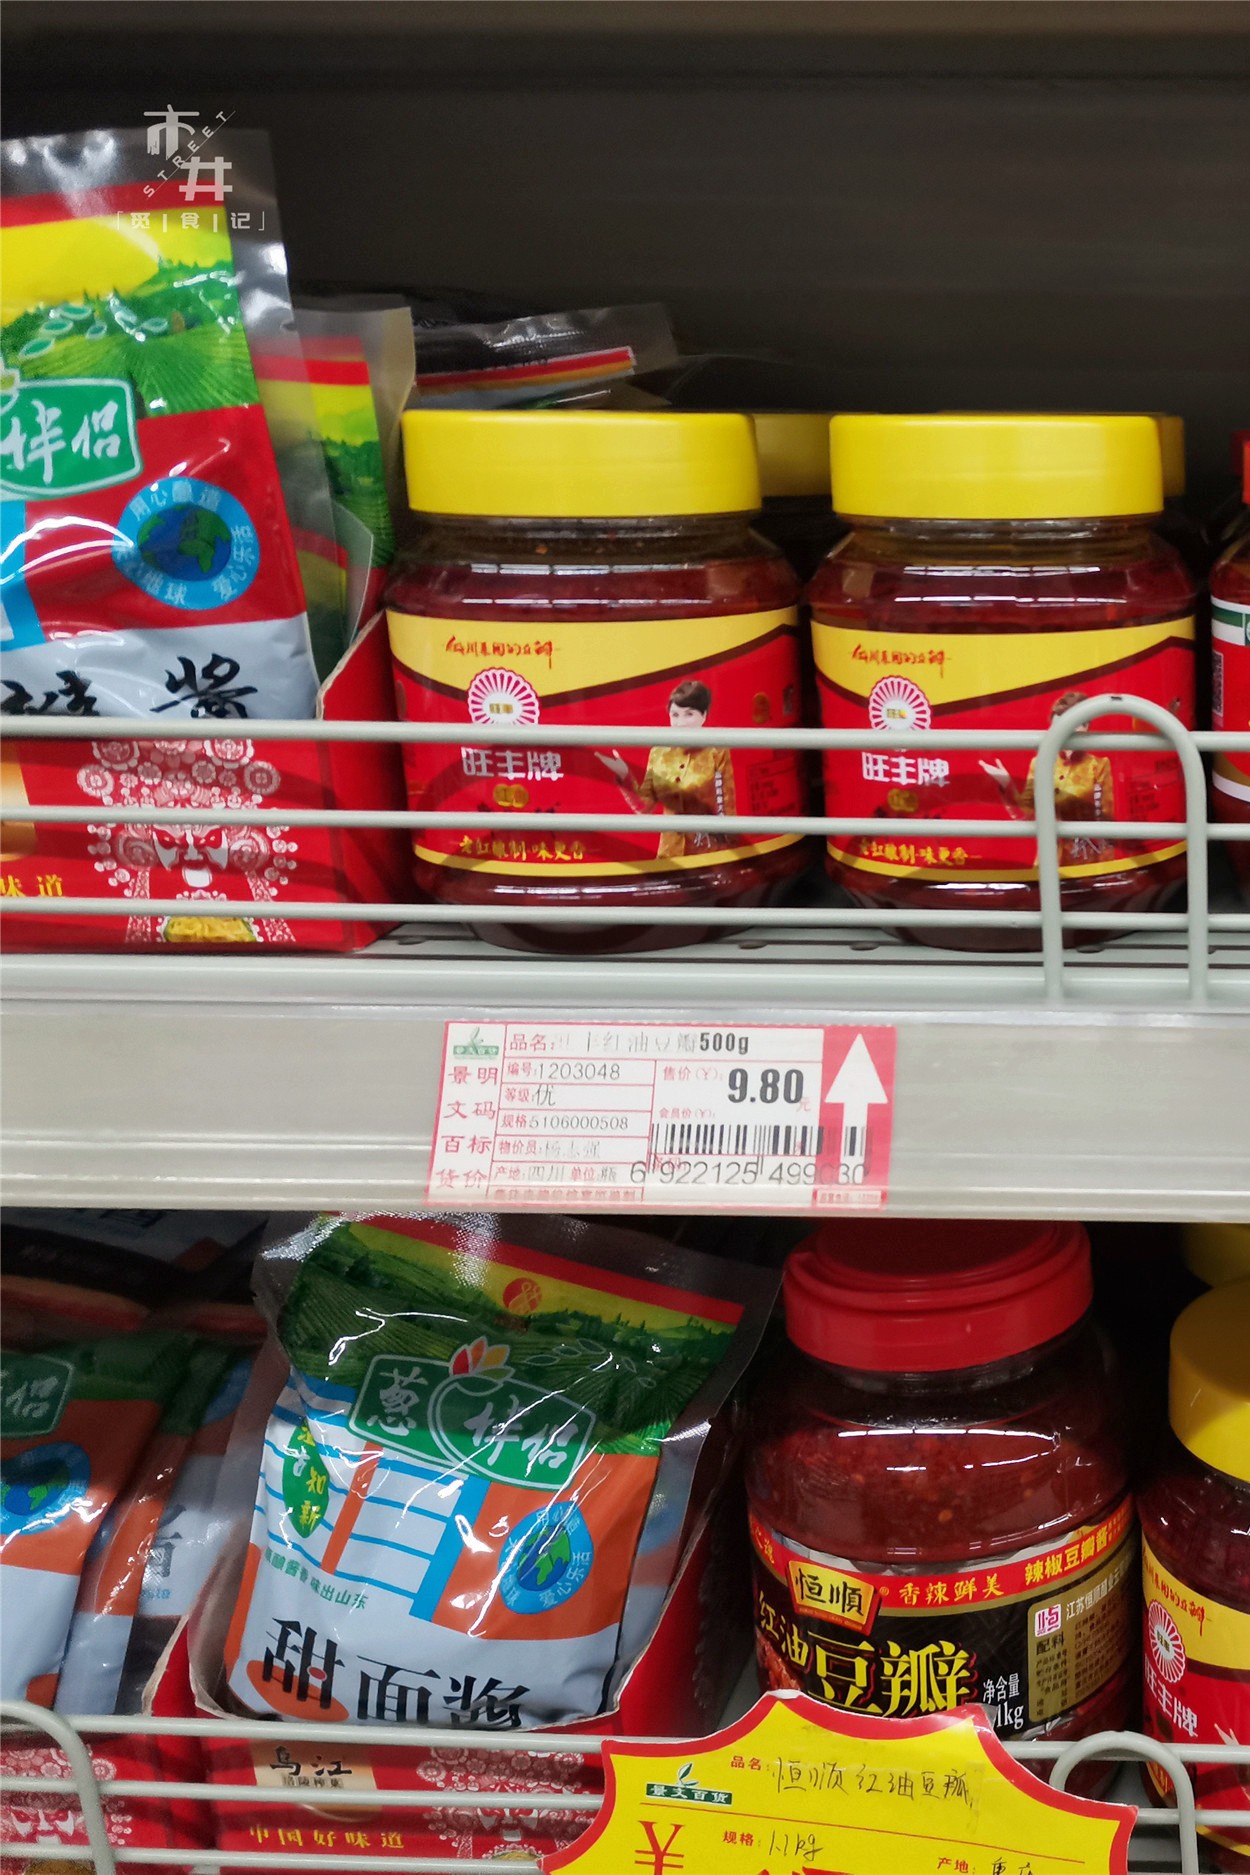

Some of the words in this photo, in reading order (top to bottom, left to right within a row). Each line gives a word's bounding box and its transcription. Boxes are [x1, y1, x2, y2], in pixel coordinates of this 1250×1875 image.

[0, 400, 121, 484] 伴侣
[539, 1063, 621, 1081] 1203048
[728, 1068, 804, 1104] 9.80
[630, 1161, 646, 1184] 6
[660, 1161, 758, 1185] 922125
[367, 1367, 579, 1468] 葱伴侣
[1024, 1525, 1109, 1582] 辣椒豆瓣酱
[898, 1573, 1005, 1606] 香辣鲜美
[263, 1617, 531, 1727] 甜面酱
[808, 1631, 970, 1718] 豆瓣
[983, 1673, 1020, 1704] 净含量
[270, 1746, 352, 1776] 乌江
[651, 1786, 731, 1804] 景文百货
[250, 1823, 404, 1848] 中国好味道
